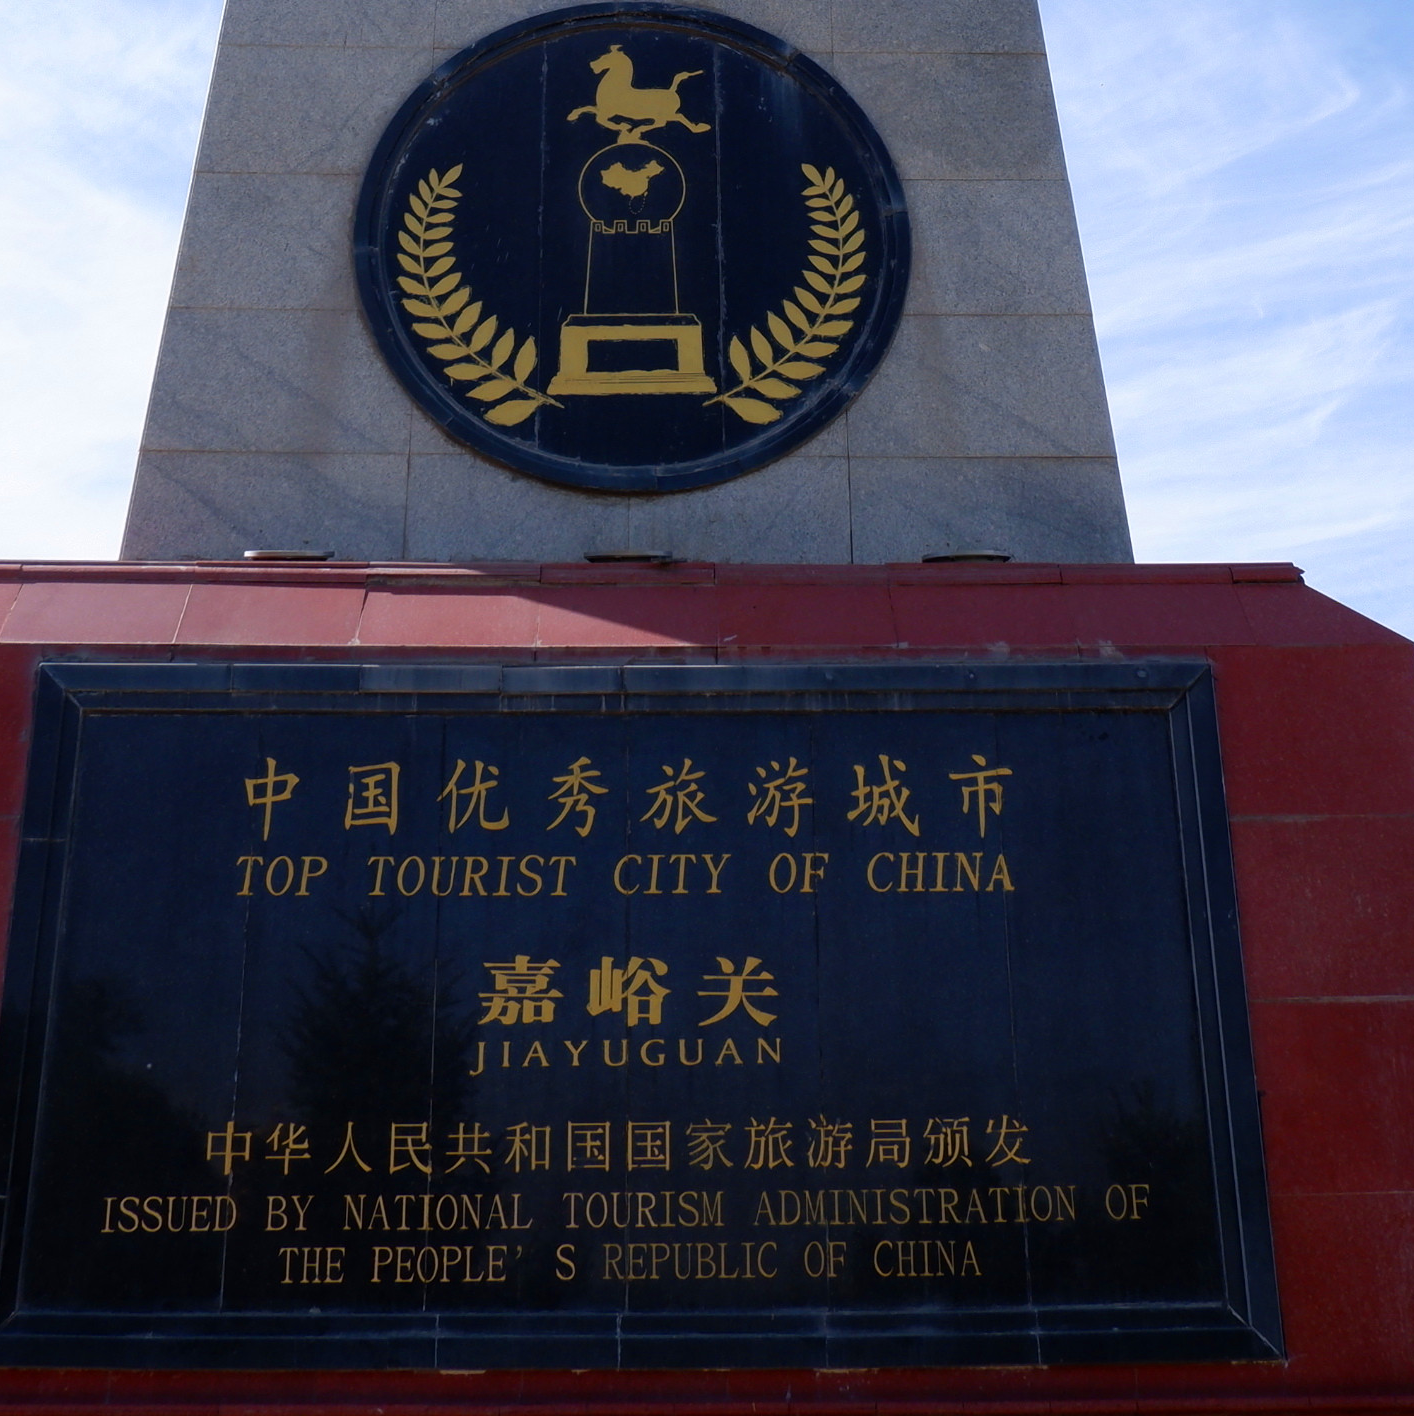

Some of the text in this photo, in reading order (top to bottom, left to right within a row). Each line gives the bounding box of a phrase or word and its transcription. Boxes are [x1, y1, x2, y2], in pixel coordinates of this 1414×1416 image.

[244, 754, 1013, 841] 中国优秀旅游城市
[236, 852, 1016, 897] TOP TOURIST CITY OF CHINA
[477, 954, 780, 1027] 嘉峪关
[469, 1037, 782, 1077] JIAYUGUAN
[206, 1115, 1032, 1176] 中华人民共和国国家旅游局颁发
[100, 1184, 1150, 1233] ISSUED BY NATIONAL TOURISM ADMINISTRATION OF
[278, 1247, 346, 1284] THE
[603, 1242, 778, 1280] REPUBLIC
[804, 1241, 848, 1278] OF
[874, 1240, 983, 1277] CHINA
